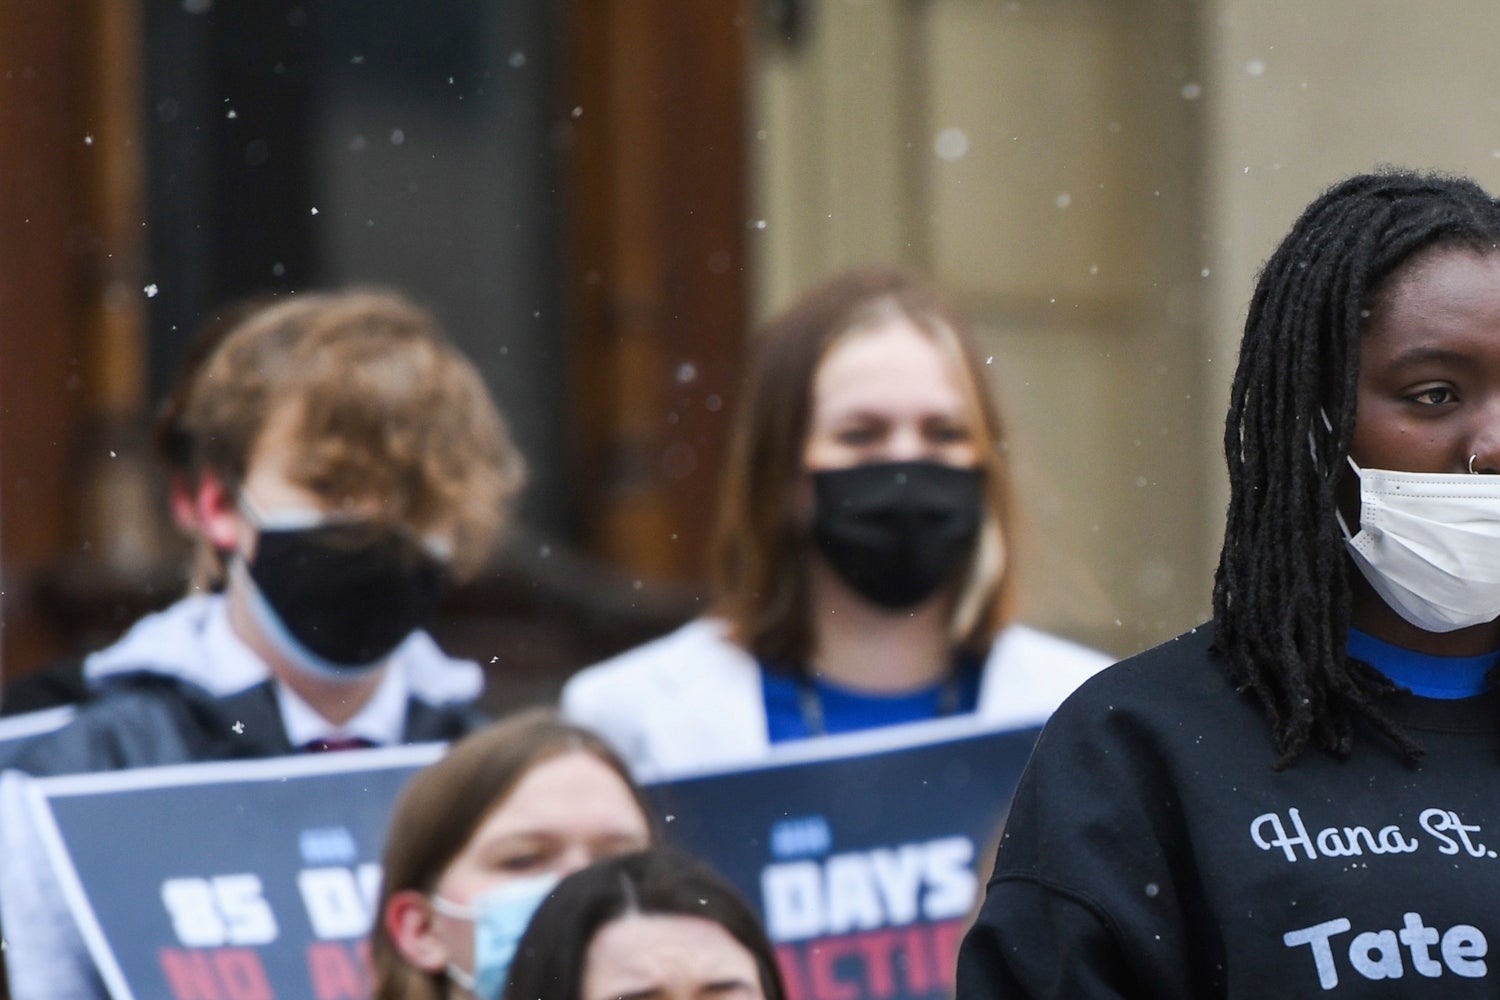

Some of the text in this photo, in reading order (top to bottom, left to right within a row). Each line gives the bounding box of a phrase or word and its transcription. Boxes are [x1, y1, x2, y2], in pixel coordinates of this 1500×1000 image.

[1250, 807, 1419, 862] Hana
[1418, 807, 1498, 859] St.
[761, 836, 979, 942] DAYS
[1283, 912, 1488, 990] Tate
